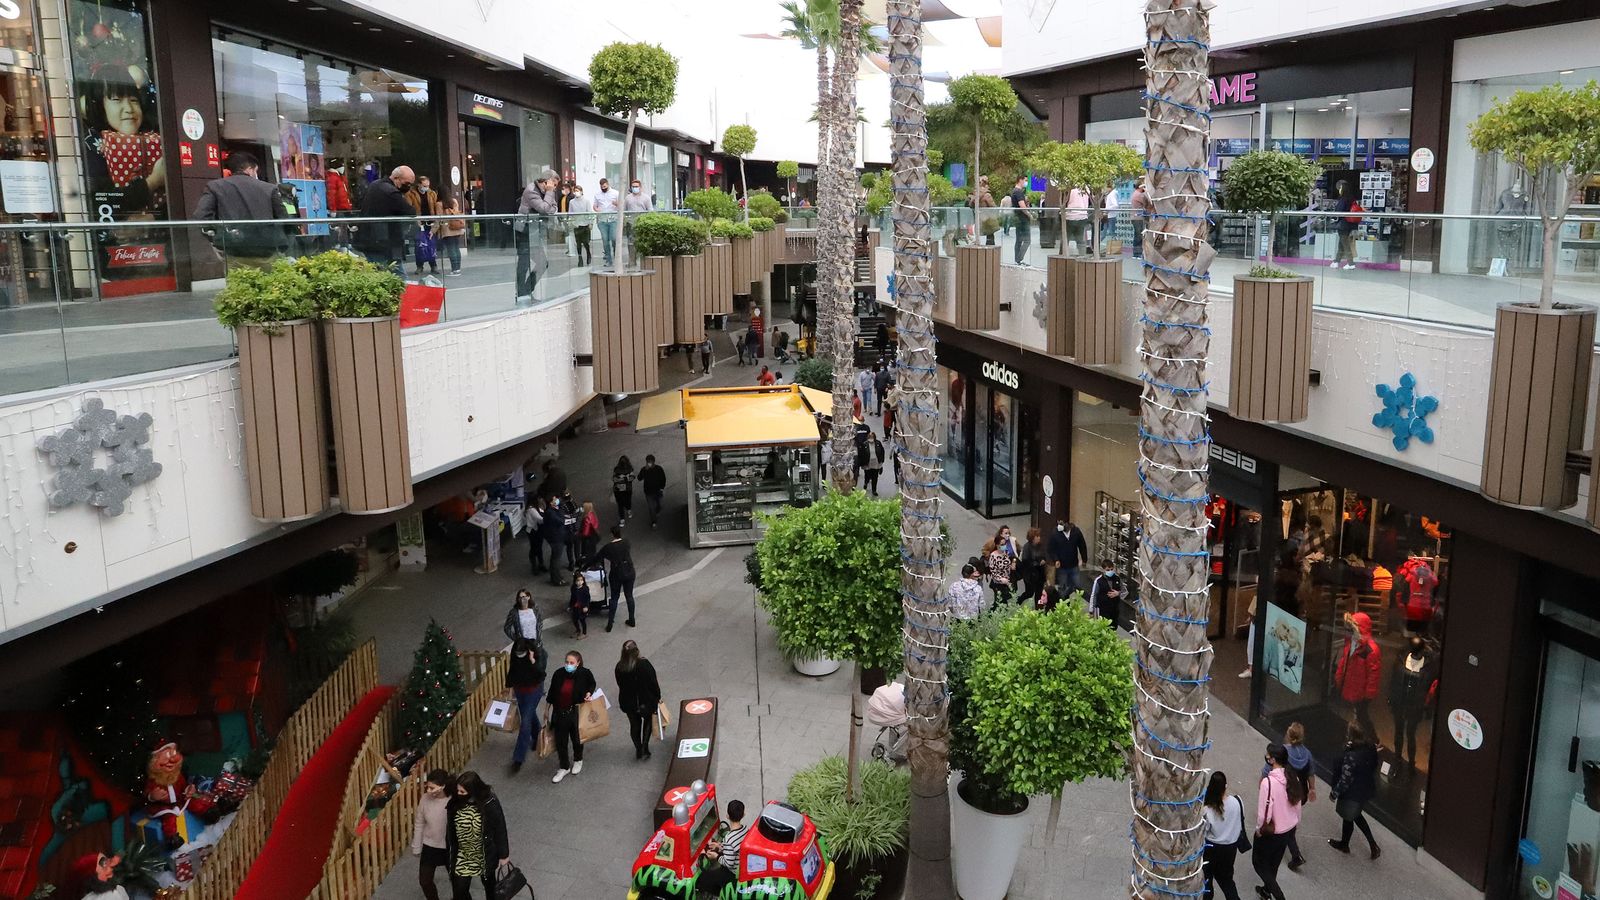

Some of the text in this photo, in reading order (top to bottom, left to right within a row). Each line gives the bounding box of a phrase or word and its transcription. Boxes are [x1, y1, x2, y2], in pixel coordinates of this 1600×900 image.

[115, 248, 159, 260] Felices Fiestas
[982, 360, 1019, 389] adidas
